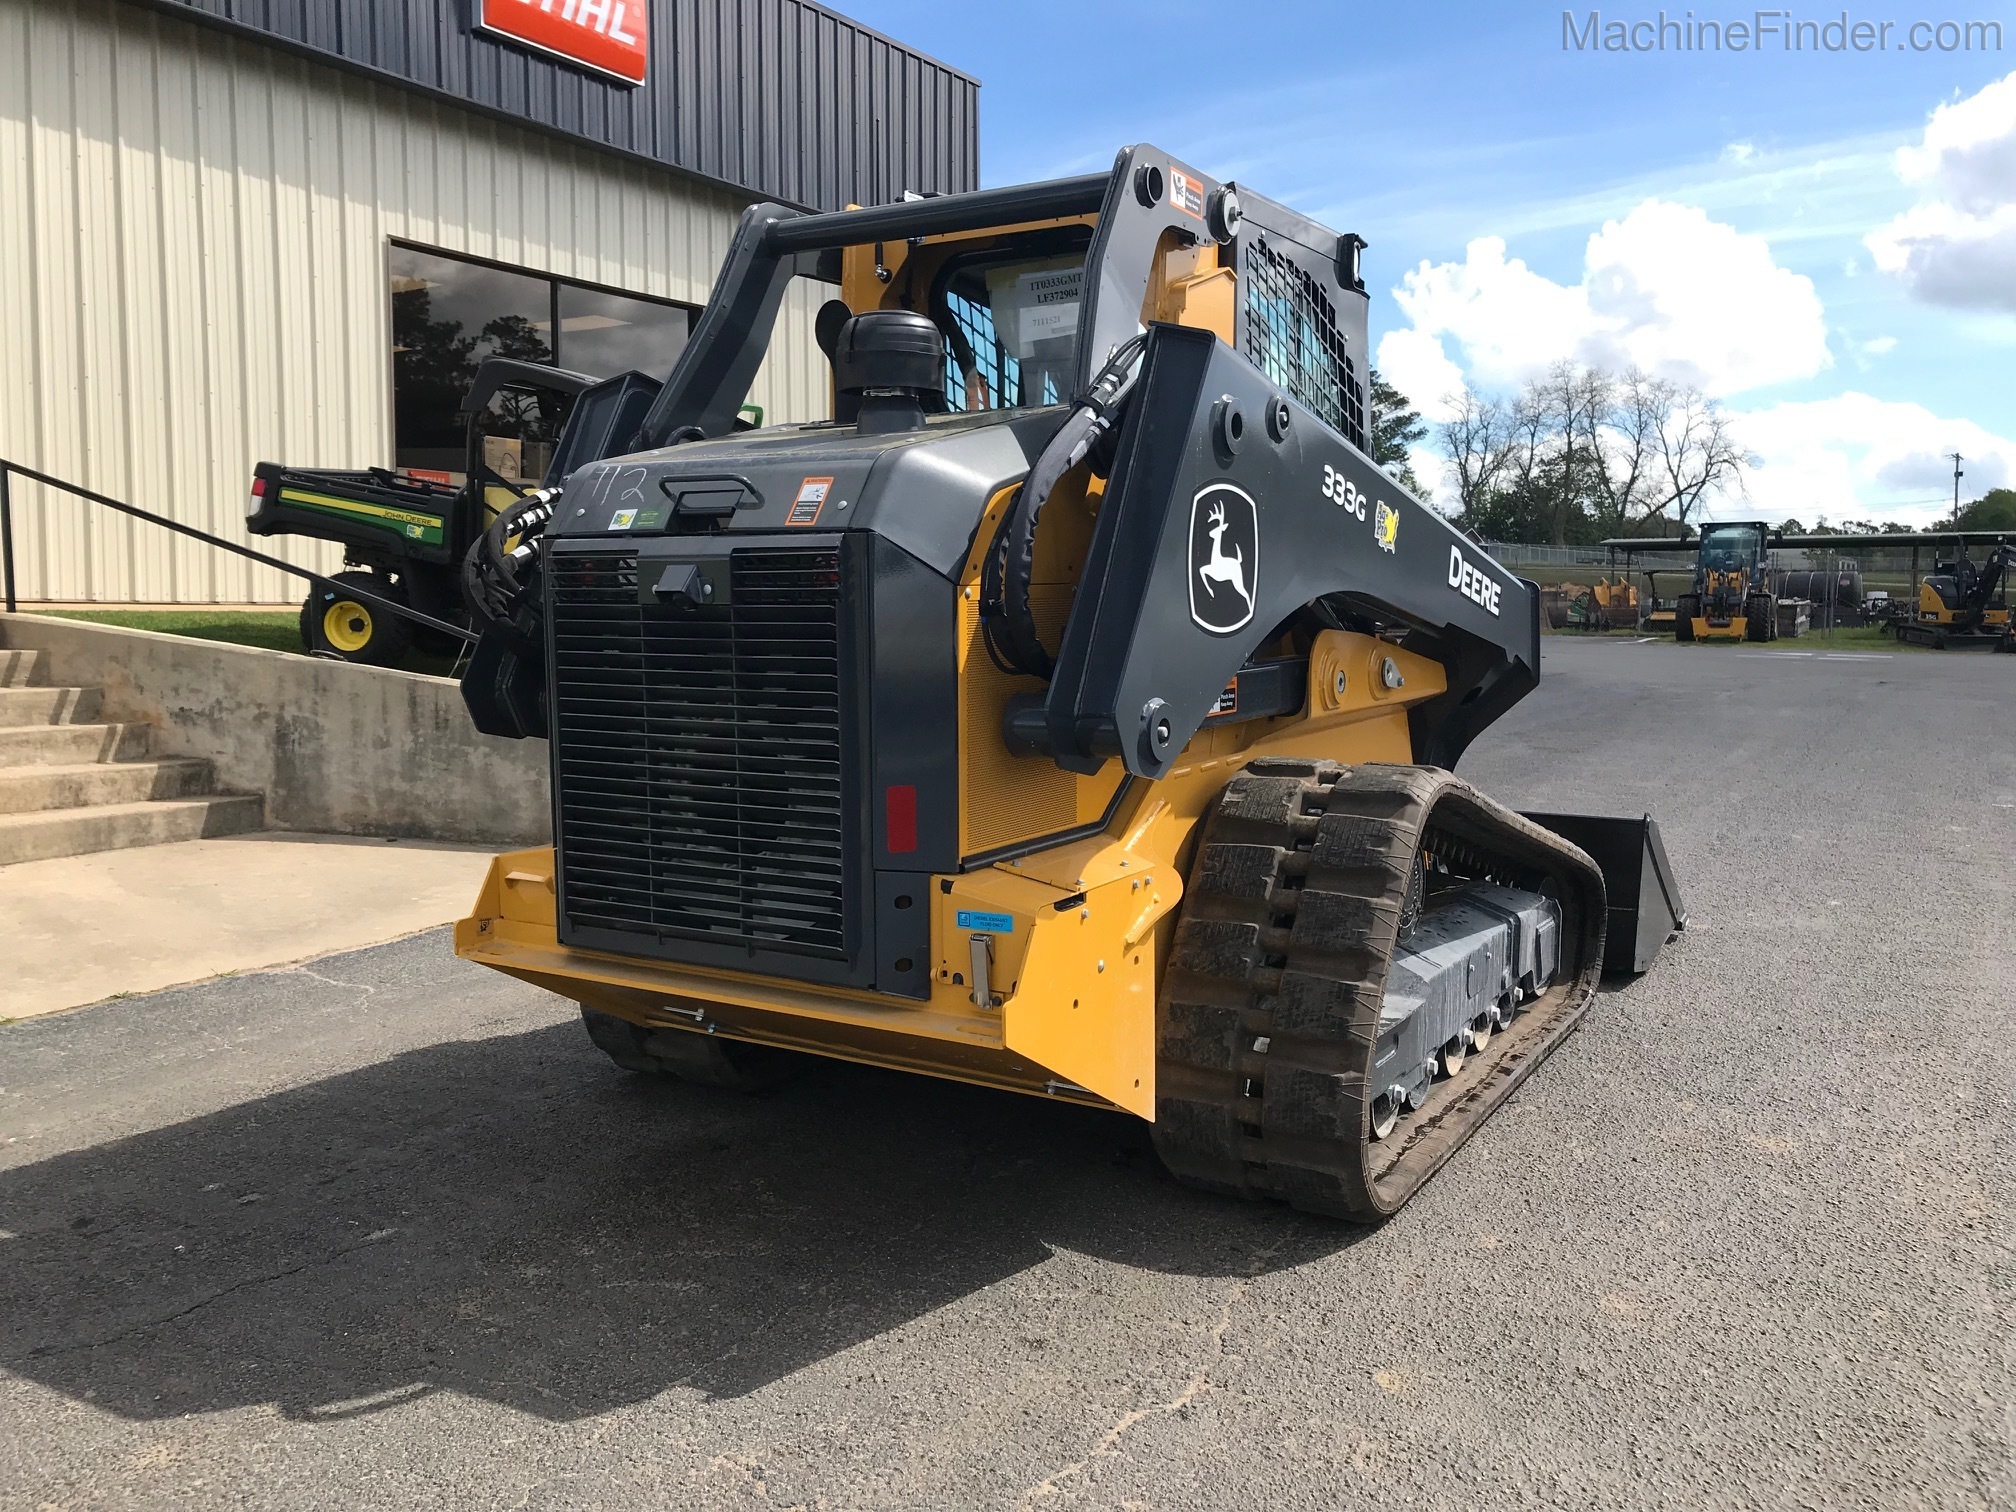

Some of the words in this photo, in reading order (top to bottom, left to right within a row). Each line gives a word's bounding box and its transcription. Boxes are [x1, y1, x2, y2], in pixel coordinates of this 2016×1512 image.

[518, 0, 636, 46] IHL
[1030, 273, 1083, 291] 1T0333GMT
[1037, 288, 1078, 304] LF372904
[1321, 464, 1367, 522] 333G
[382, 510, 404, 520] JOHN
[405, 514, 433, 526] DEERE
[1448, 545, 1502, 616] DEERE
